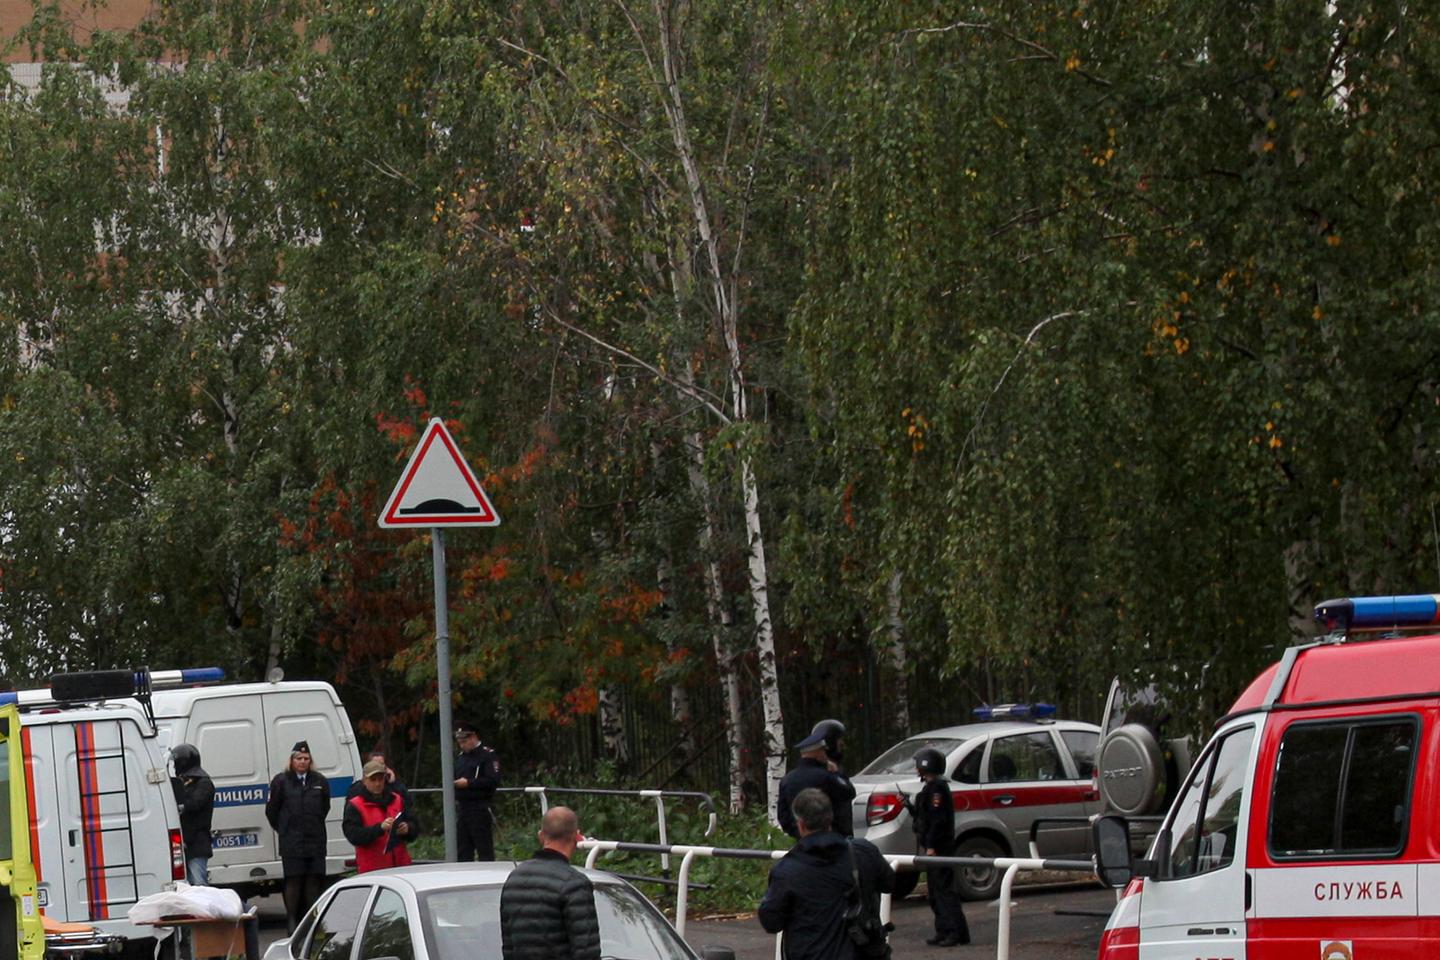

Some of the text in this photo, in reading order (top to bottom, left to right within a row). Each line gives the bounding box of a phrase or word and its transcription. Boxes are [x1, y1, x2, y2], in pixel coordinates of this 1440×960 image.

[213, 789, 264, 803] ЛИЦИЯ
[211, 836, 241, 848] 0051
[1314, 881, 1404, 901] СЛУЖБА
